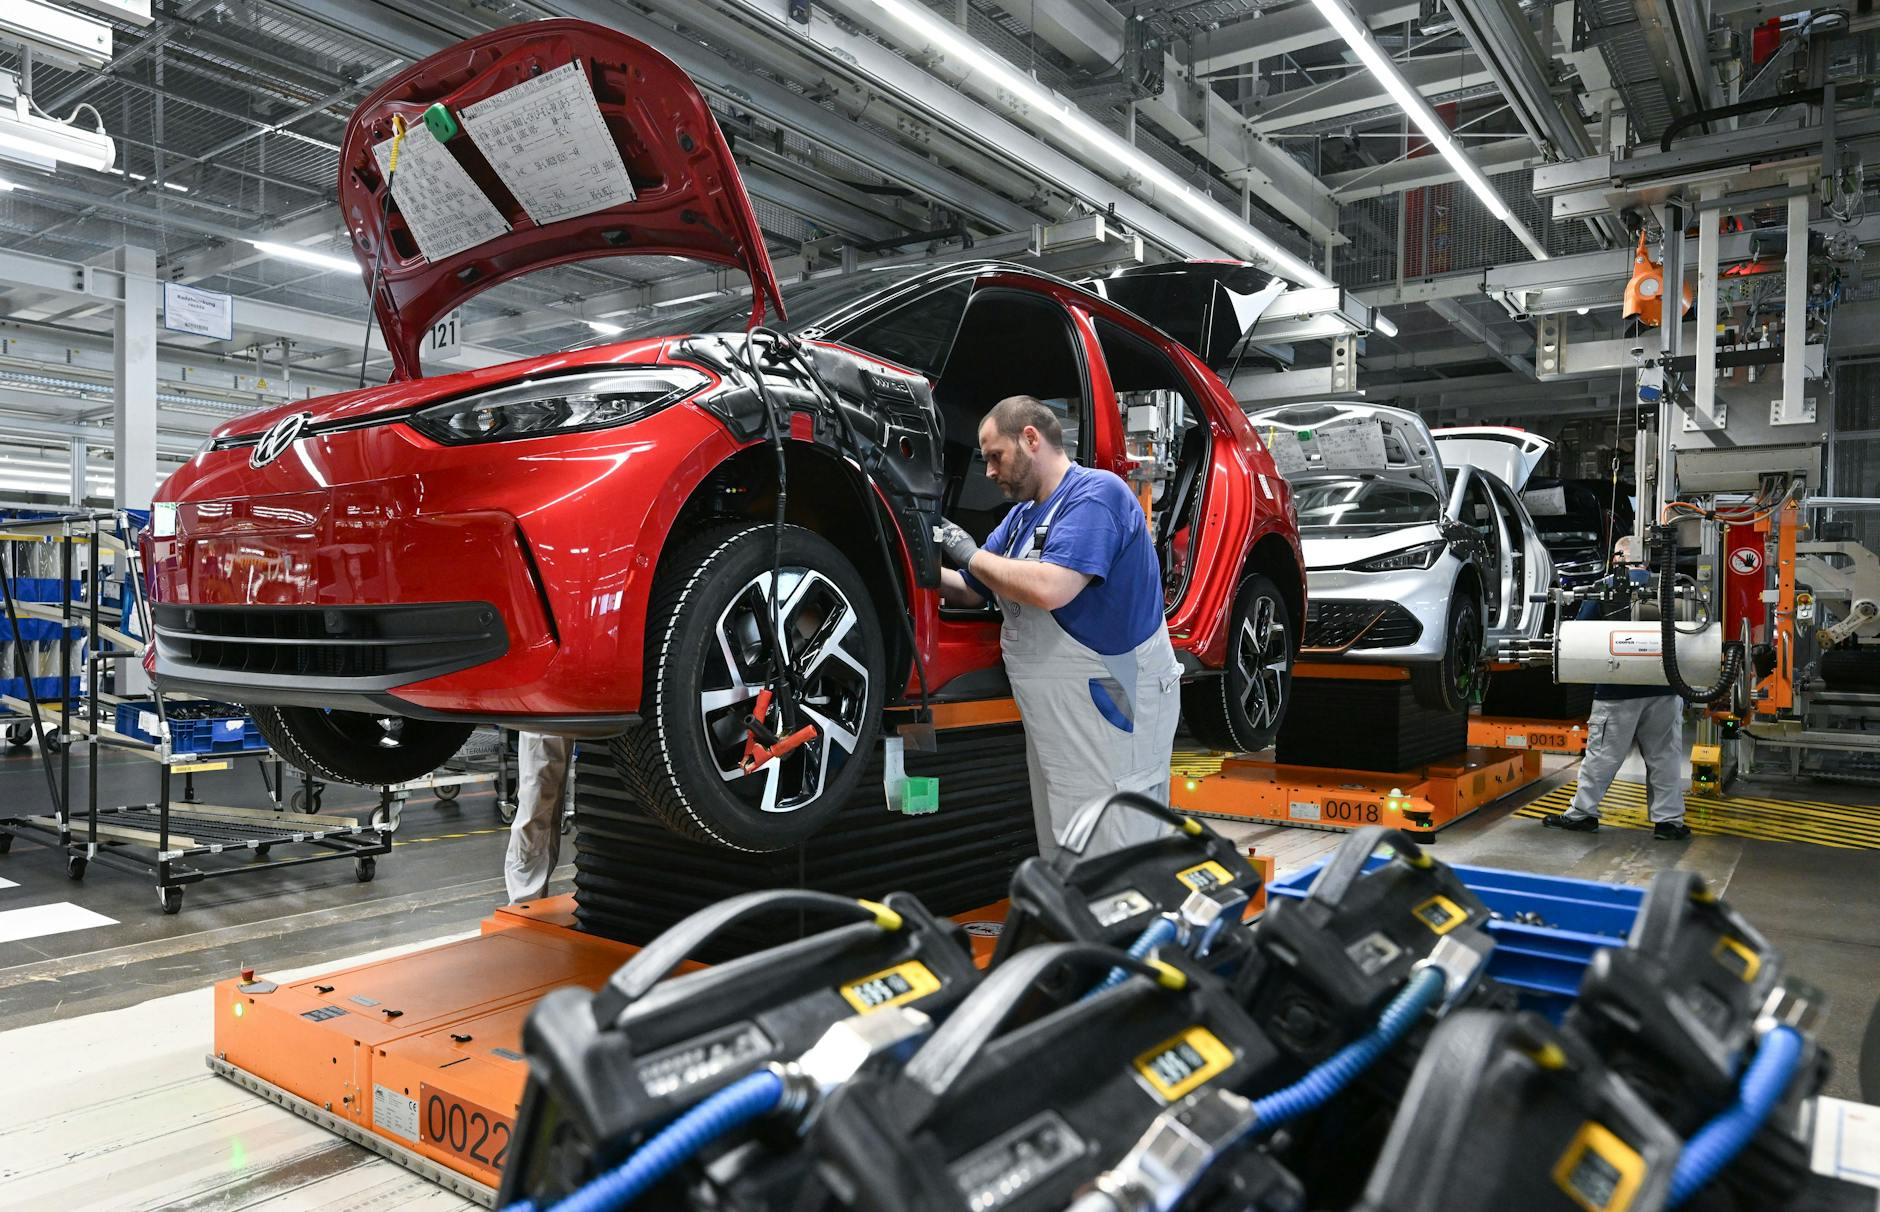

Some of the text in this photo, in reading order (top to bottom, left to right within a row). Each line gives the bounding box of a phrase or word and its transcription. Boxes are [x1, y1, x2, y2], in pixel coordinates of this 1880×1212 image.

[431, 321, 455, 350] 121
[1530, 733, 1566, 747] 0013
[1326, 800, 1379, 823] 0018
[428, 1094, 512, 1170] 0022
